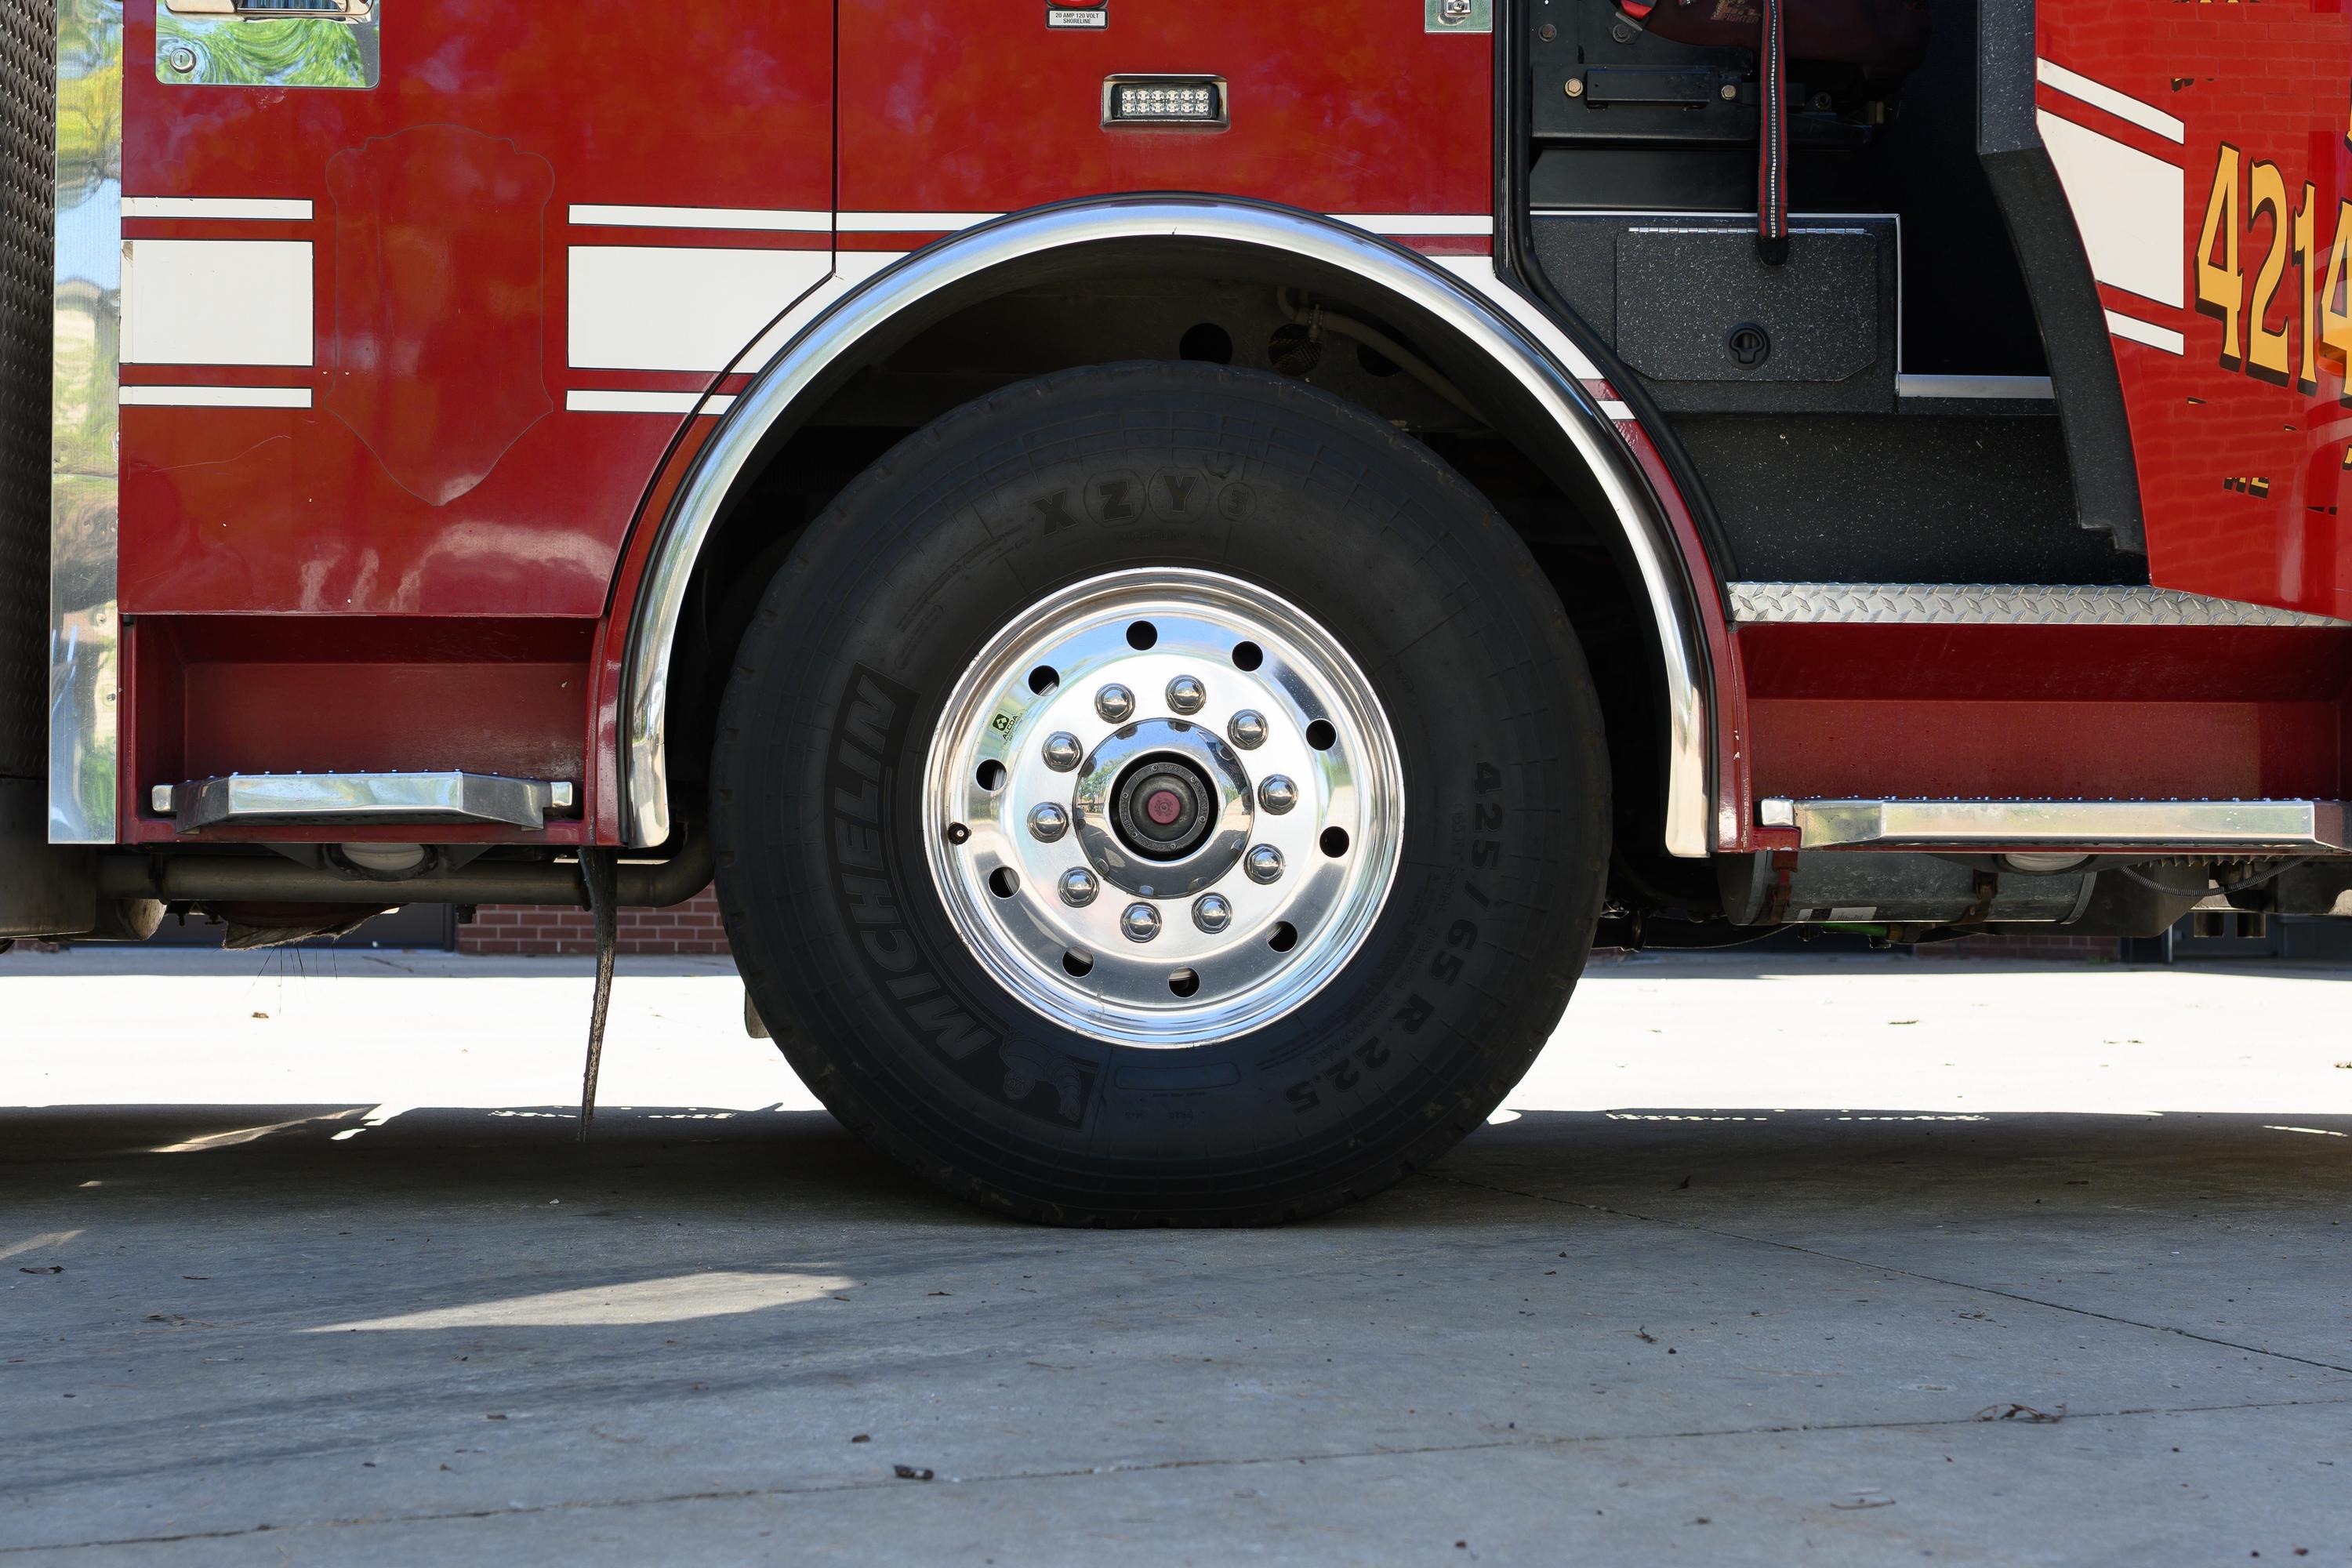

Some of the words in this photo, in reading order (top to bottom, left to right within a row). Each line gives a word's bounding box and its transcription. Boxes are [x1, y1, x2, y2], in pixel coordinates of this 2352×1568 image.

[1723, 13, 1760, 24] FIGHTER
[1003, 715, 1018, 740] ALCOA
[834, 675, 996, 1060] MICHELIN
[1283, 1036, 1391, 1114] 22.5
